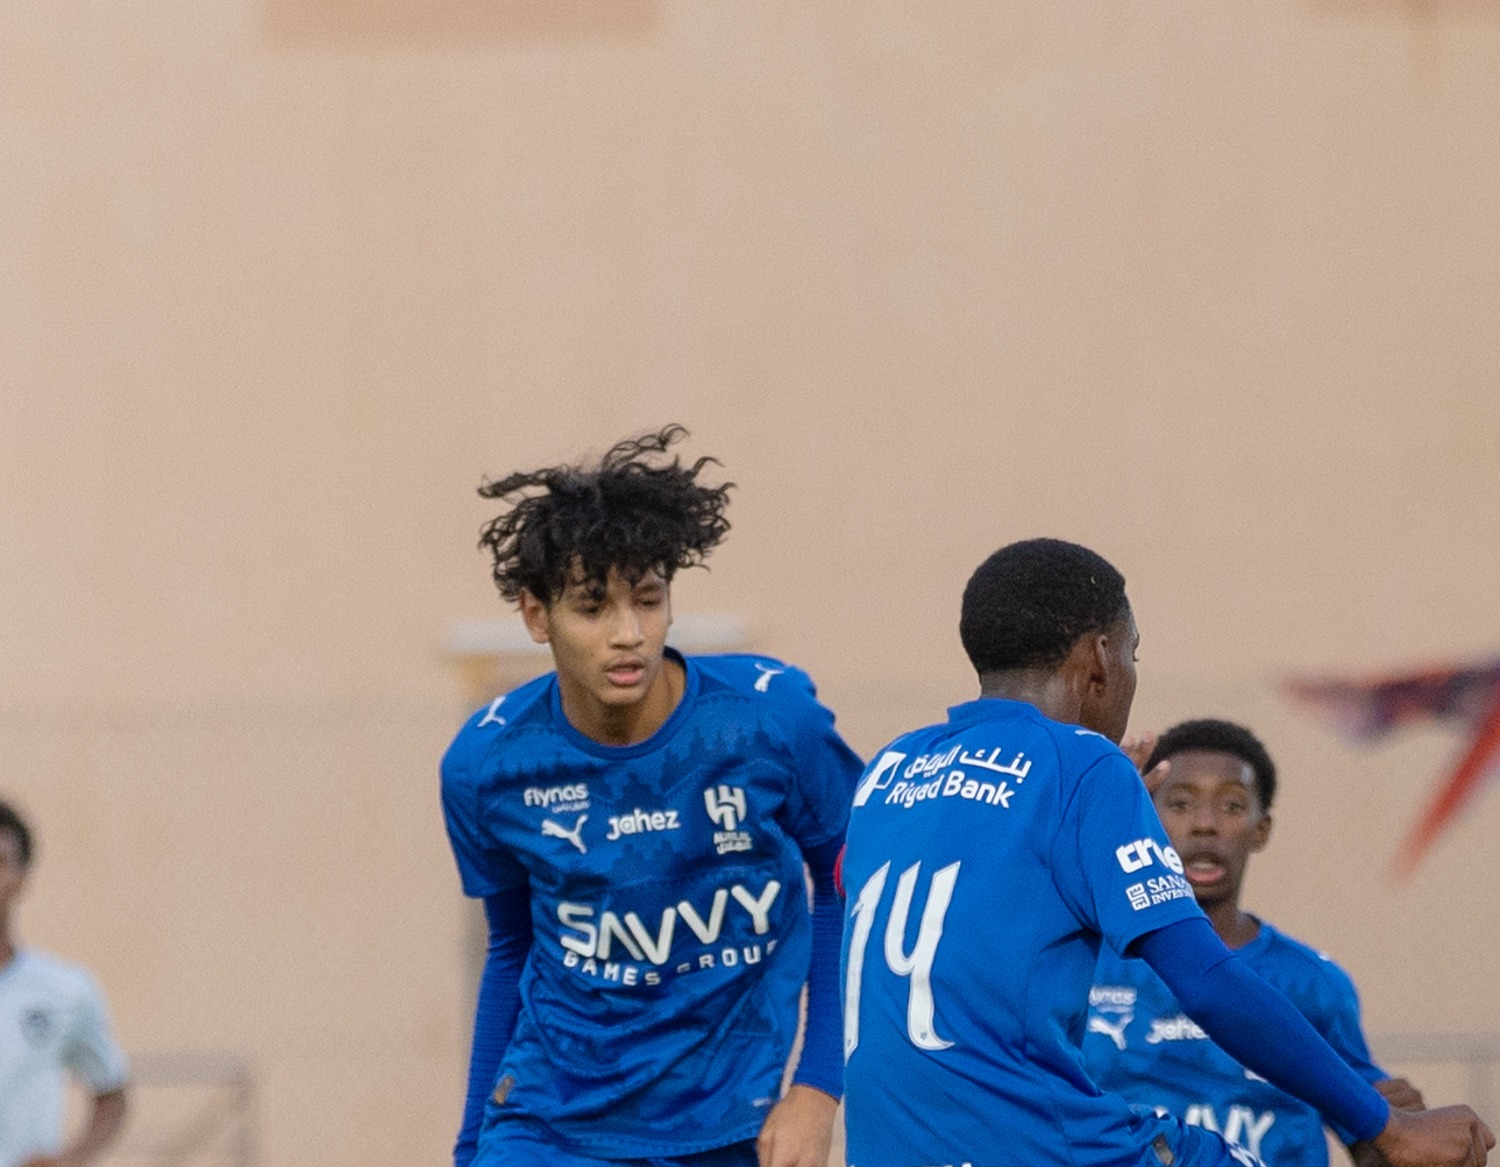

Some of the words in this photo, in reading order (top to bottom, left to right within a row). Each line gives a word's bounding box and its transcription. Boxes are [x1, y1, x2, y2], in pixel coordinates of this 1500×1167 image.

[903, 744, 962, 779] الرياض
[959, 747, 1032, 784] بنك
[523, 782, 590, 808] flynas
[884, 774, 945, 809] Riyad
[942, 770, 1016, 809] Bank
[557, 879, 781, 965] SAVVY
[563, 950, 662, 986] GAMES
[844, 860, 961, 1067] 14
